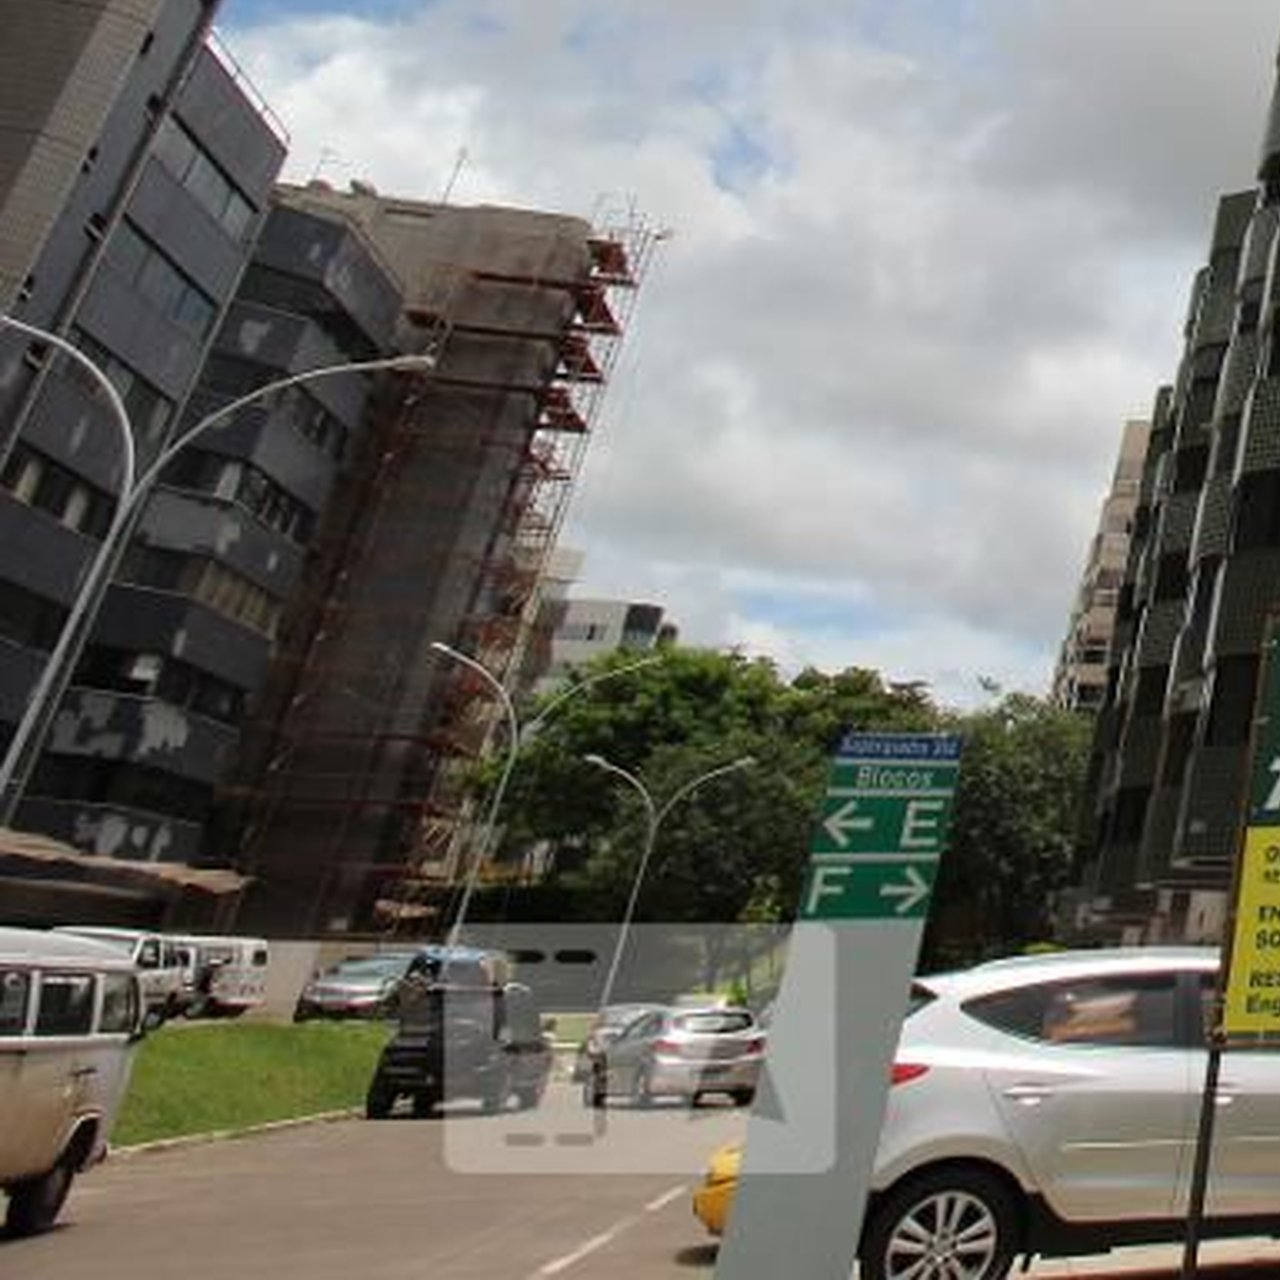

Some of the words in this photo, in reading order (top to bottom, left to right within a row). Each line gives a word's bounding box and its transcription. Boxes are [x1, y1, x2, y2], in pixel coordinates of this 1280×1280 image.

[857, 766, 934, 788] Blocos
[901, 800, 945, 847] E
[806, 867, 853, 915] F
